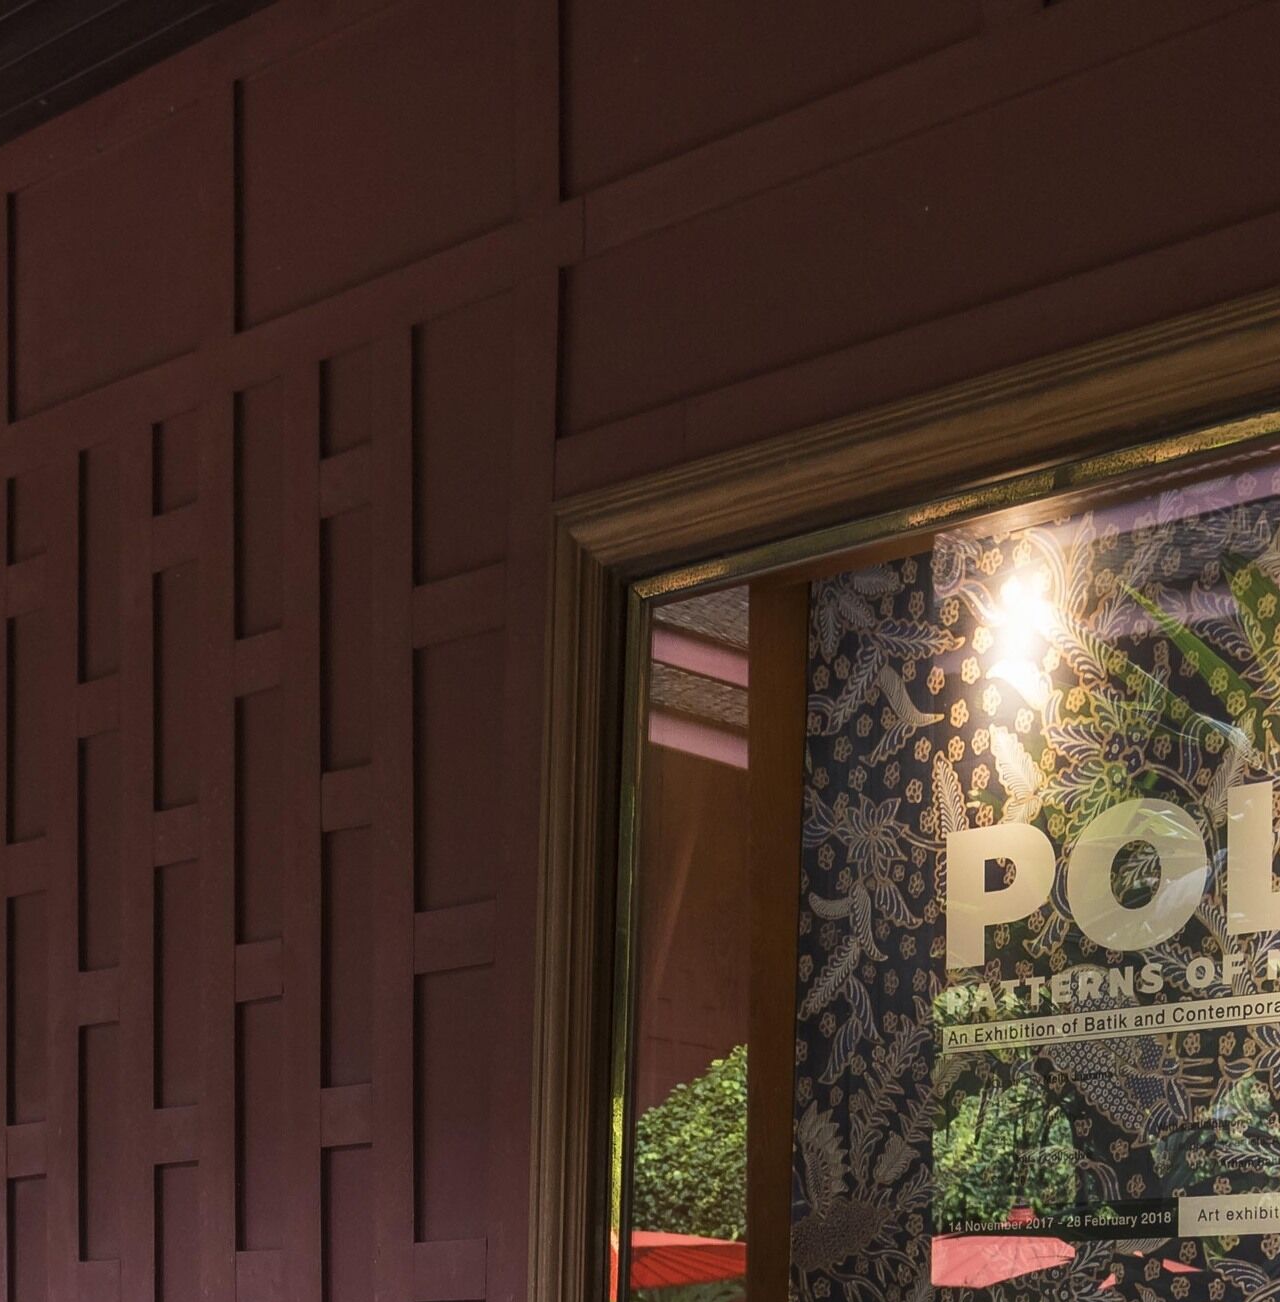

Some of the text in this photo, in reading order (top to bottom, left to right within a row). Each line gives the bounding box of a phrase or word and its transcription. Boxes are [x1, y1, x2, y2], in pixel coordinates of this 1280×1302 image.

[946, 962, 1164, 1015] PATTERNS
[1186, 954, 1244, 988] OF
[948, 1030, 969, 1046] An
[974, 1023, 1056, 1042] Exhibition
[1062, 1019, 1078, 1034] of
[1085, 1015, 1127, 1031] Batik
[1135, 1010, 1166, 1027] and
[948, 1222, 961, 1232] 14
[965, 1219, 1022, 1232] November
[1026, 1217, 1054, 1230] 2017
[1066, 1216, 1081, 1228] 28
[1085, 1213, 1138, 1228] February
[1141, 1211, 1171, 1225] 2018
[1198, 1208, 1220, 1222] Art
